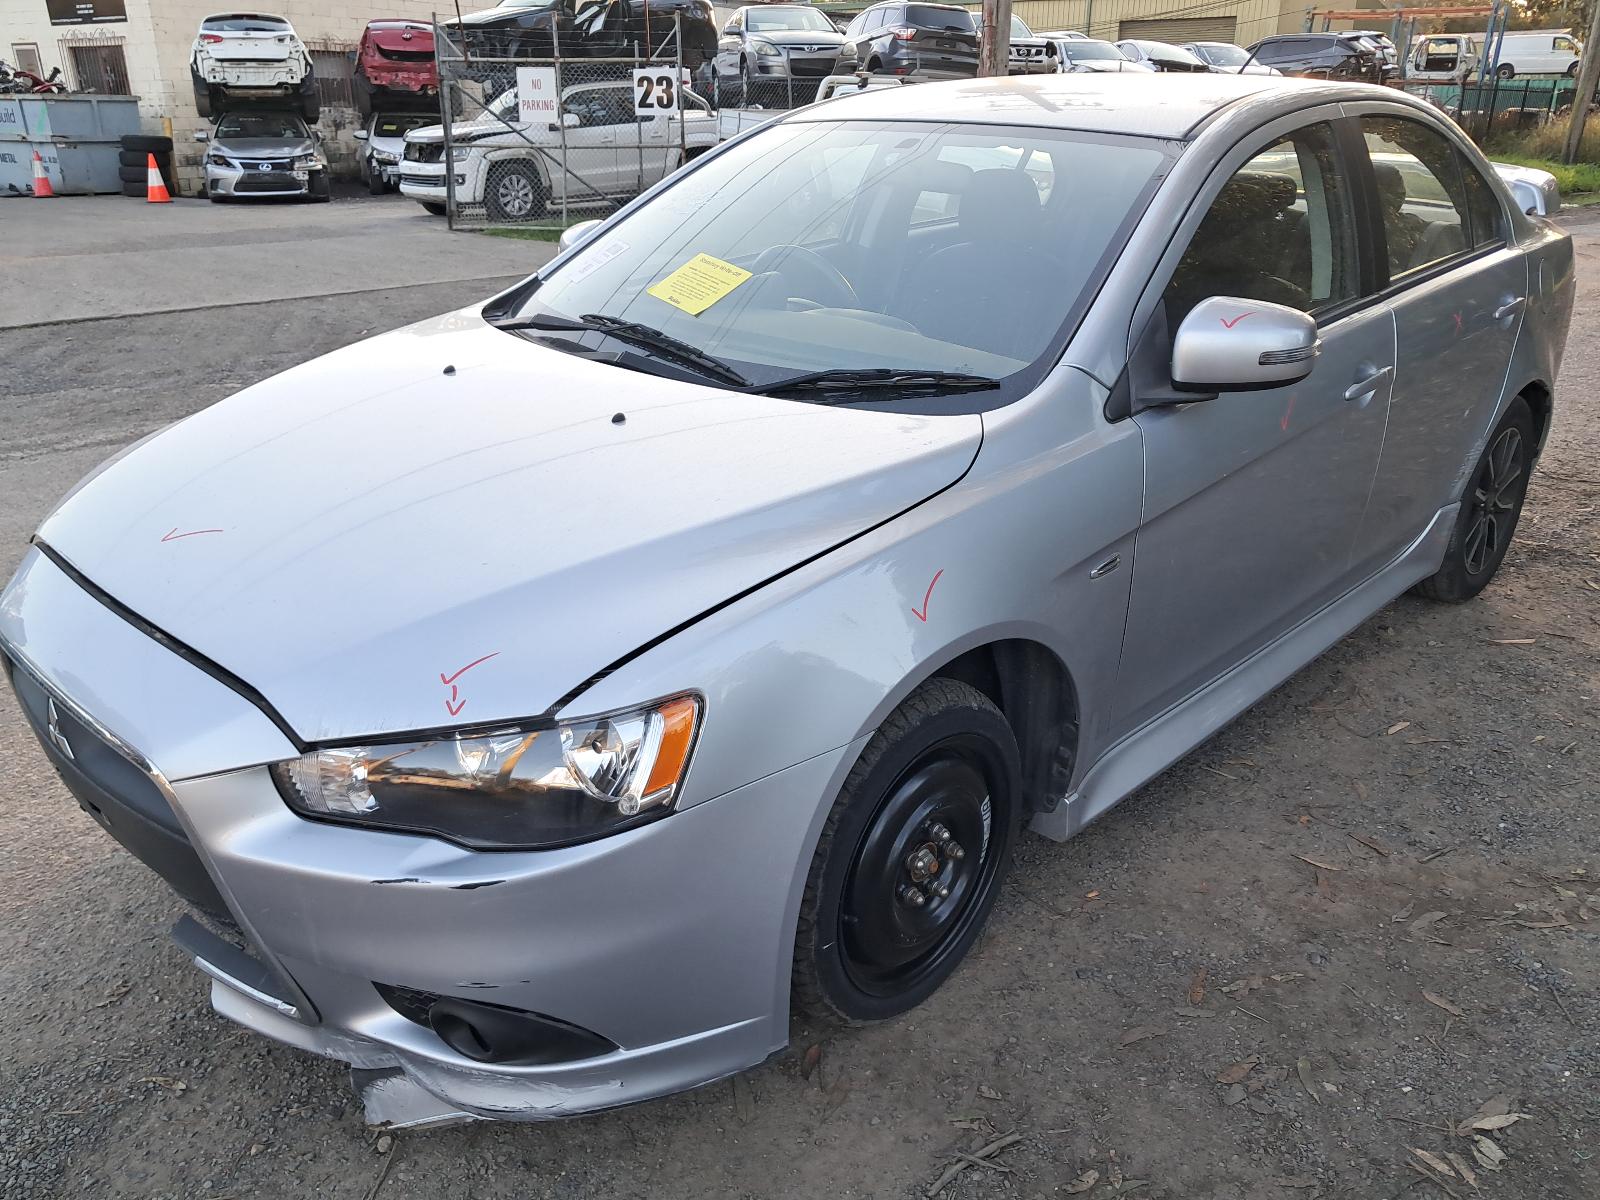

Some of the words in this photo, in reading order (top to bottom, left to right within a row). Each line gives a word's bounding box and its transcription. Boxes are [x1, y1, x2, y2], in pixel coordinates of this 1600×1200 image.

[531, 79, 542, 90] NO
[637, 75, 674, 109] 23
[522, 100, 555, 111] PARKING
